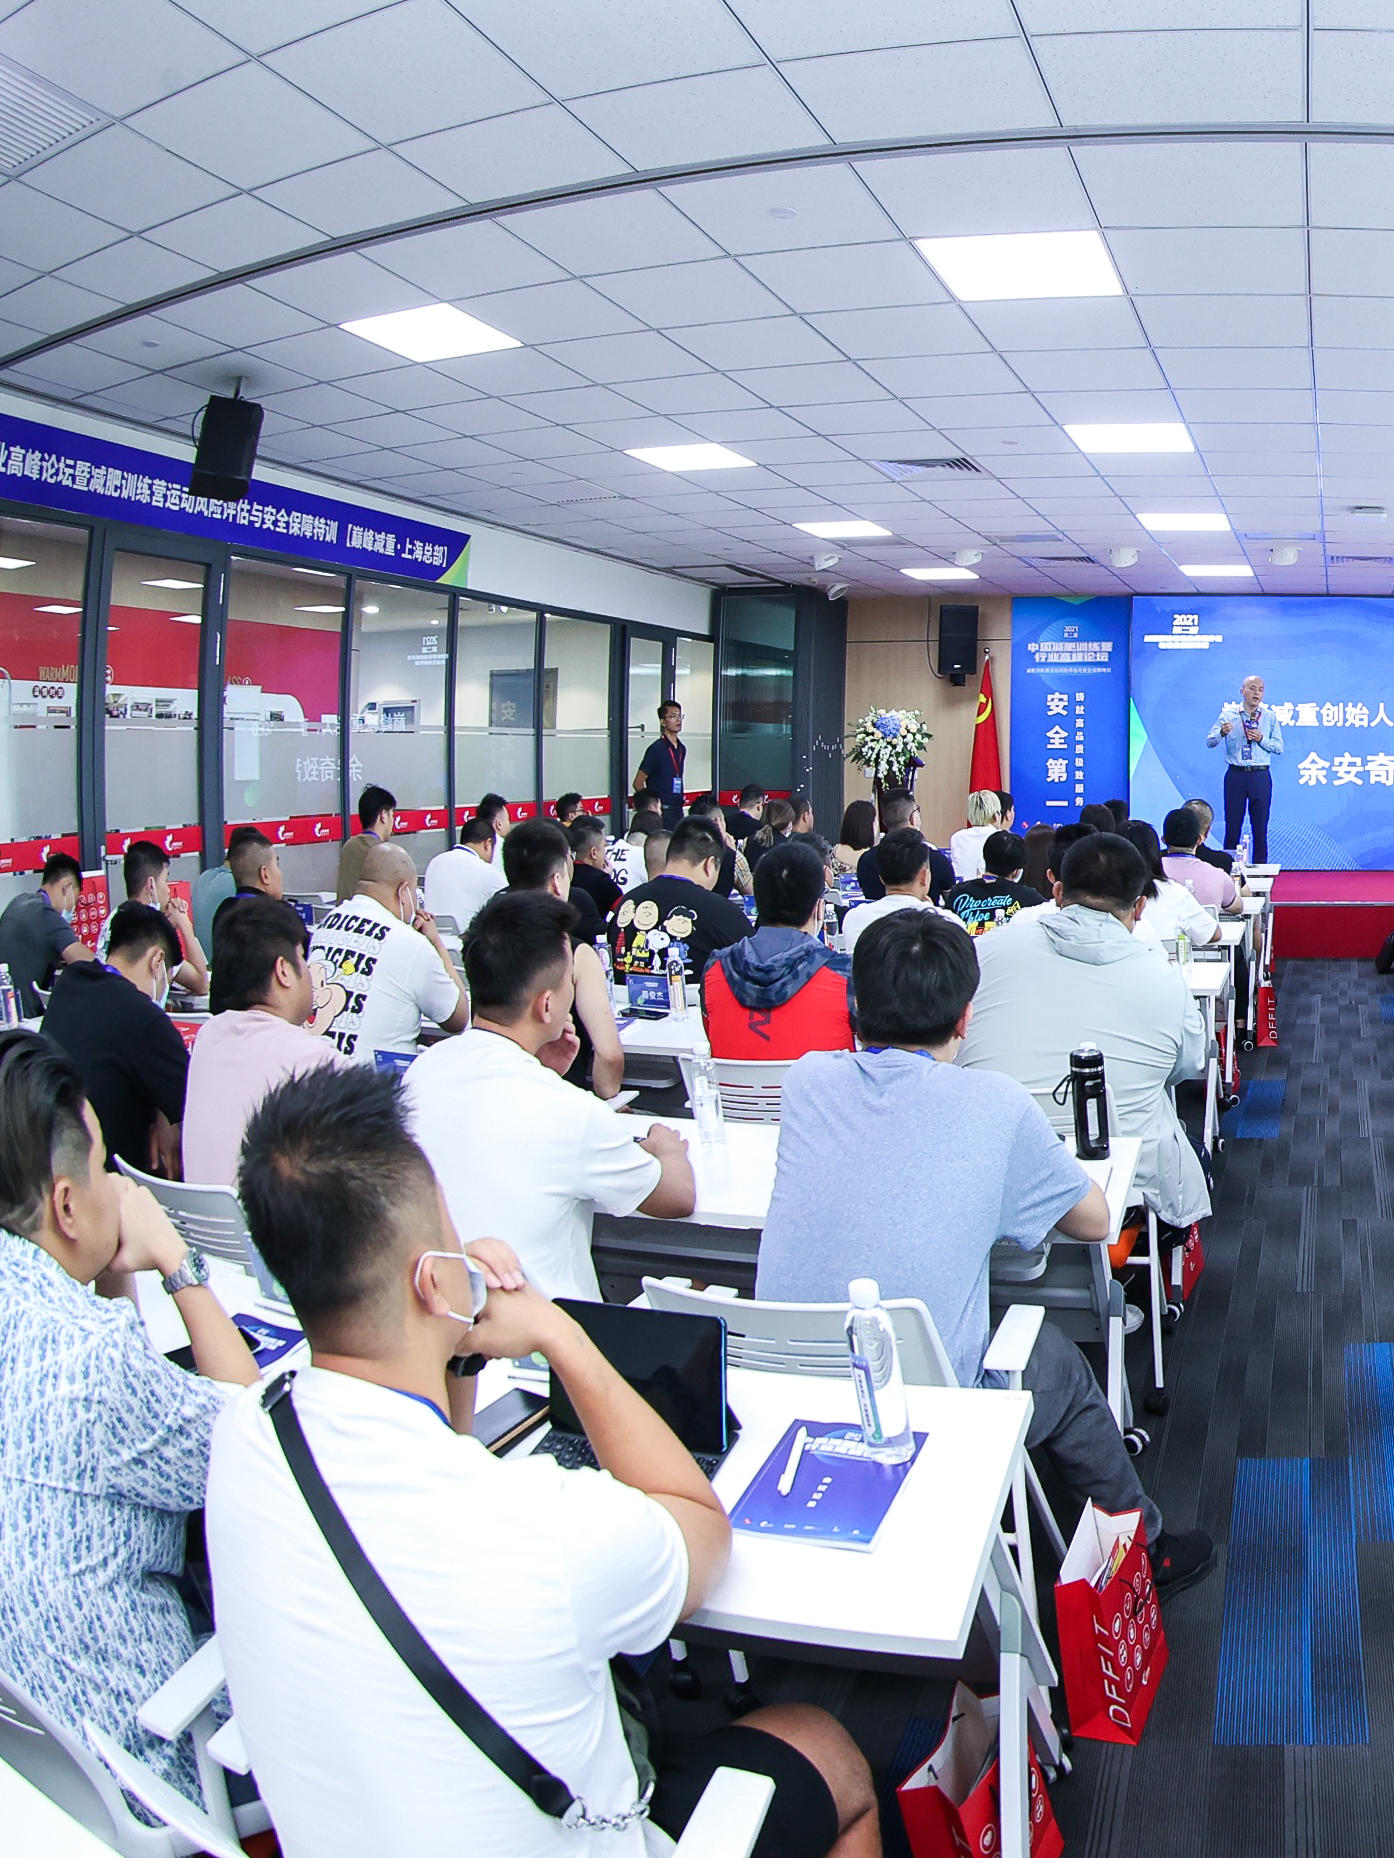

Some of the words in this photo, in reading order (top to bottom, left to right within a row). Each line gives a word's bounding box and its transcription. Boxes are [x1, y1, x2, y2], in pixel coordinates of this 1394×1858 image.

[1172, 614, 1199, 626] 2021
[1045, 691, 1069, 807] 安全第一
[1267, 998, 1278, 1039] DFFIT
[1093, 1614, 1132, 1728] DFFIT
